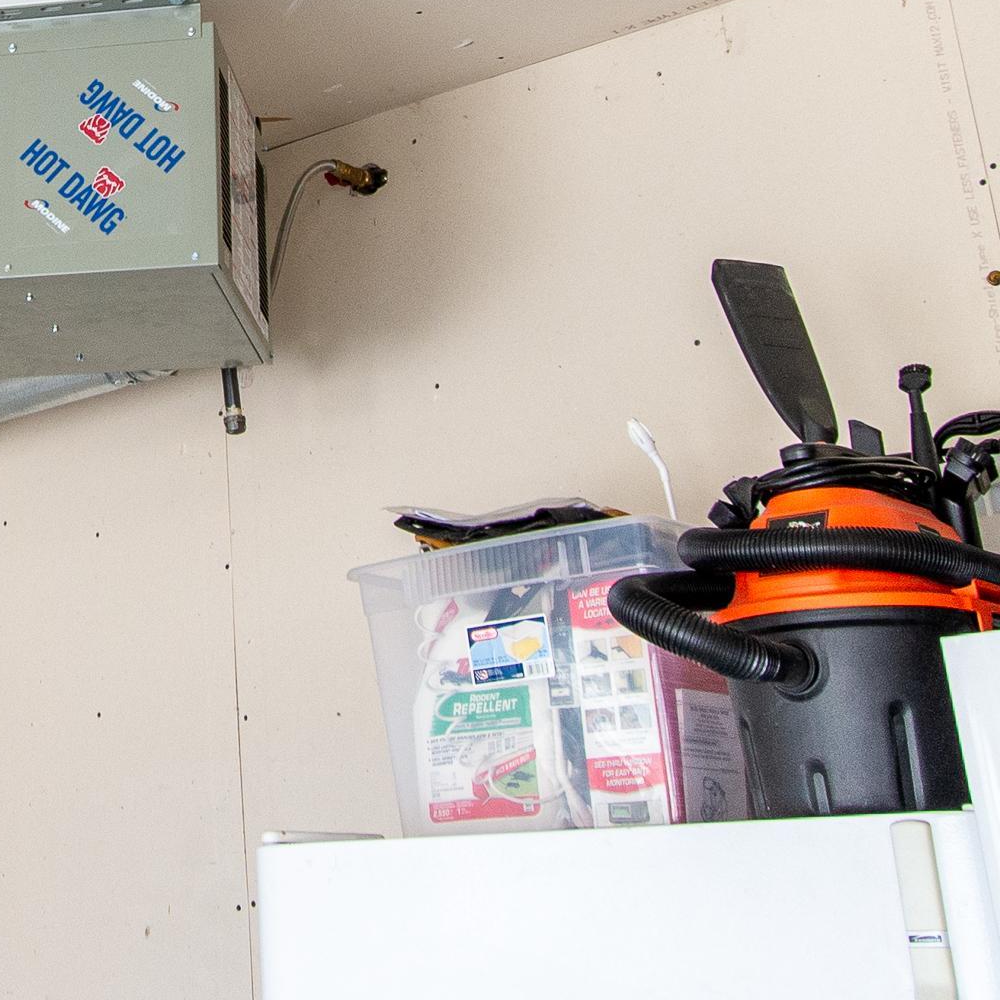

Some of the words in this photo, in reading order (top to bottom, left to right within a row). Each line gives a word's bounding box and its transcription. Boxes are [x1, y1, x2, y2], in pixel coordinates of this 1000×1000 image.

[937, 62, 951, 94] VISIT
[79, 78, 146, 140] DAWG
[132, 79, 172, 111] MODINE
[133, 127, 186, 174] HOT
[19, 138, 70, 184] HOT
[57, 171, 125, 235] DAWG
[31, 199, 70, 234] MODINE
[578, 600, 585, 609] A
[586, 597, 607, 608] VARIE
[589, 586, 600, 597] BE
[453, 698, 518, 716] REPELLENT
[470, 692, 500, 702] RODENT
